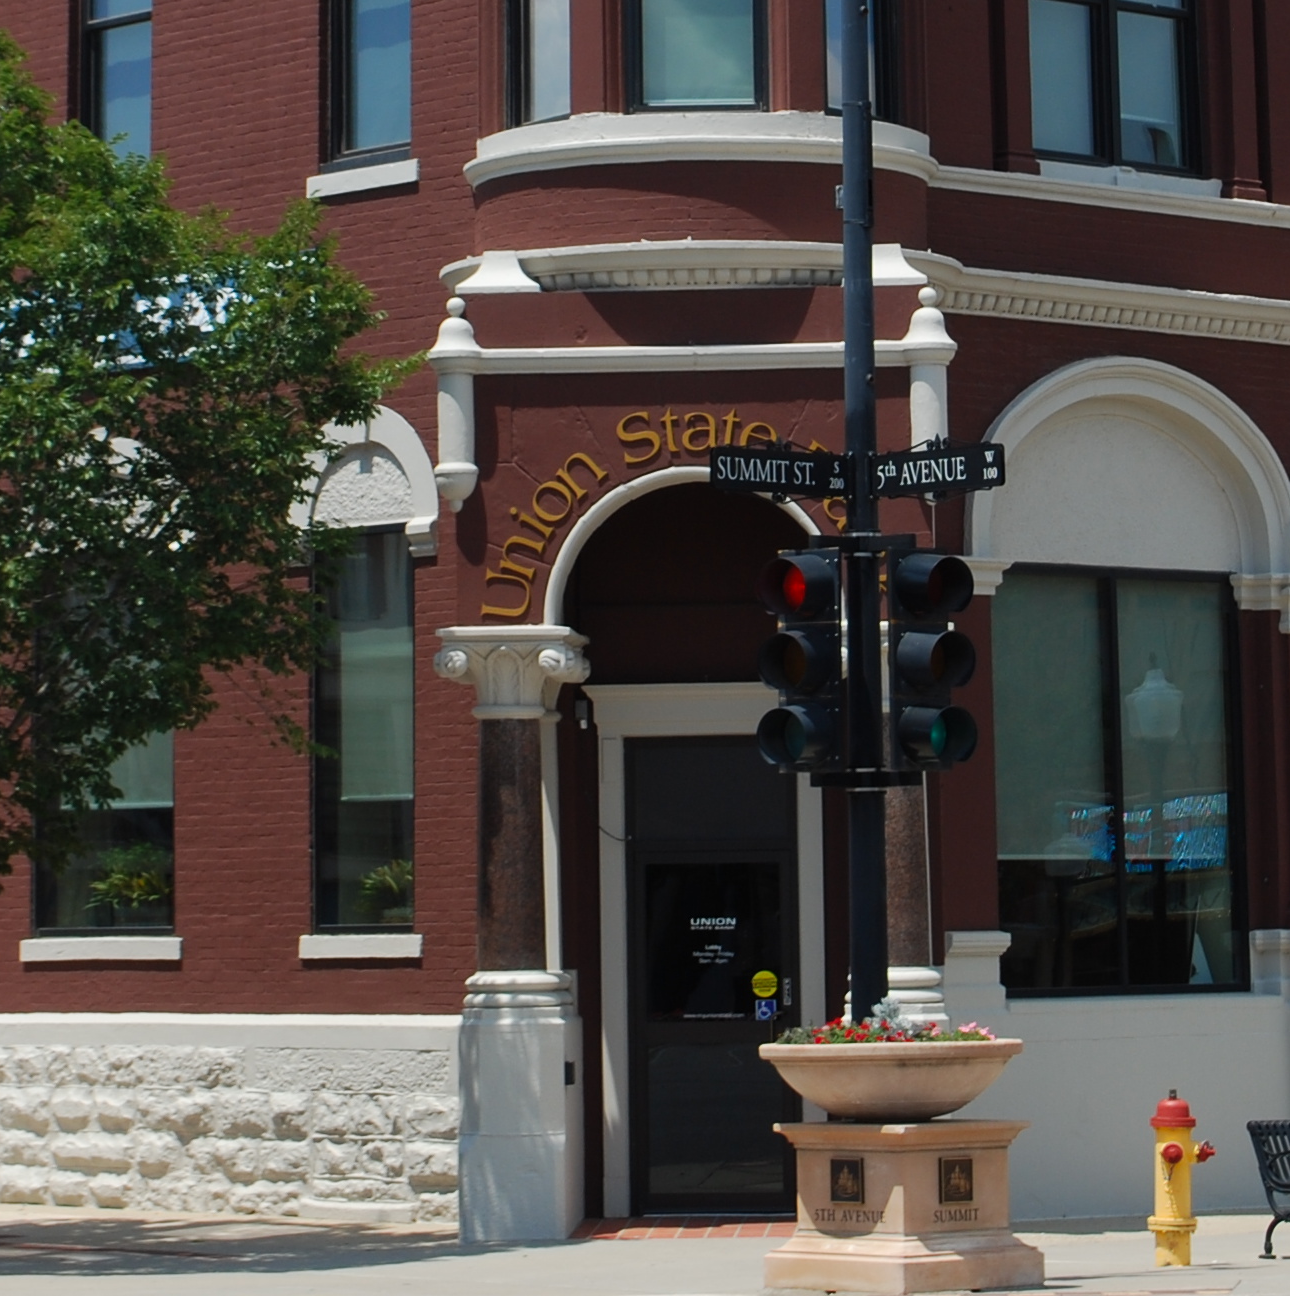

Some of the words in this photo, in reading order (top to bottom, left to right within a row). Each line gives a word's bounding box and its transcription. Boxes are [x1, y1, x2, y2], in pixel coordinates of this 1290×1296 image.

[983, 450, 996, 464] W
[716, 455, 789, 484] SUMMIT
[793, 460, 816, 486] ST.
[833, 460, 840, 474] S
[876, 459, 897, 489] 5th
[899, 456, 967, 486] AVENUE
[982, 466, 998, 480] 100
[828, 476, 845, 490] 200
[481, 451, 607, 617] Union
[616, 406, 776, 463] State
[690, 917, 736, 925] UNION
[814, 1208, 836, 1222] 5TH
[840, 1209, 886, 1223] AVENUE
[933, 1207, 980, 1223] SUMMIT
